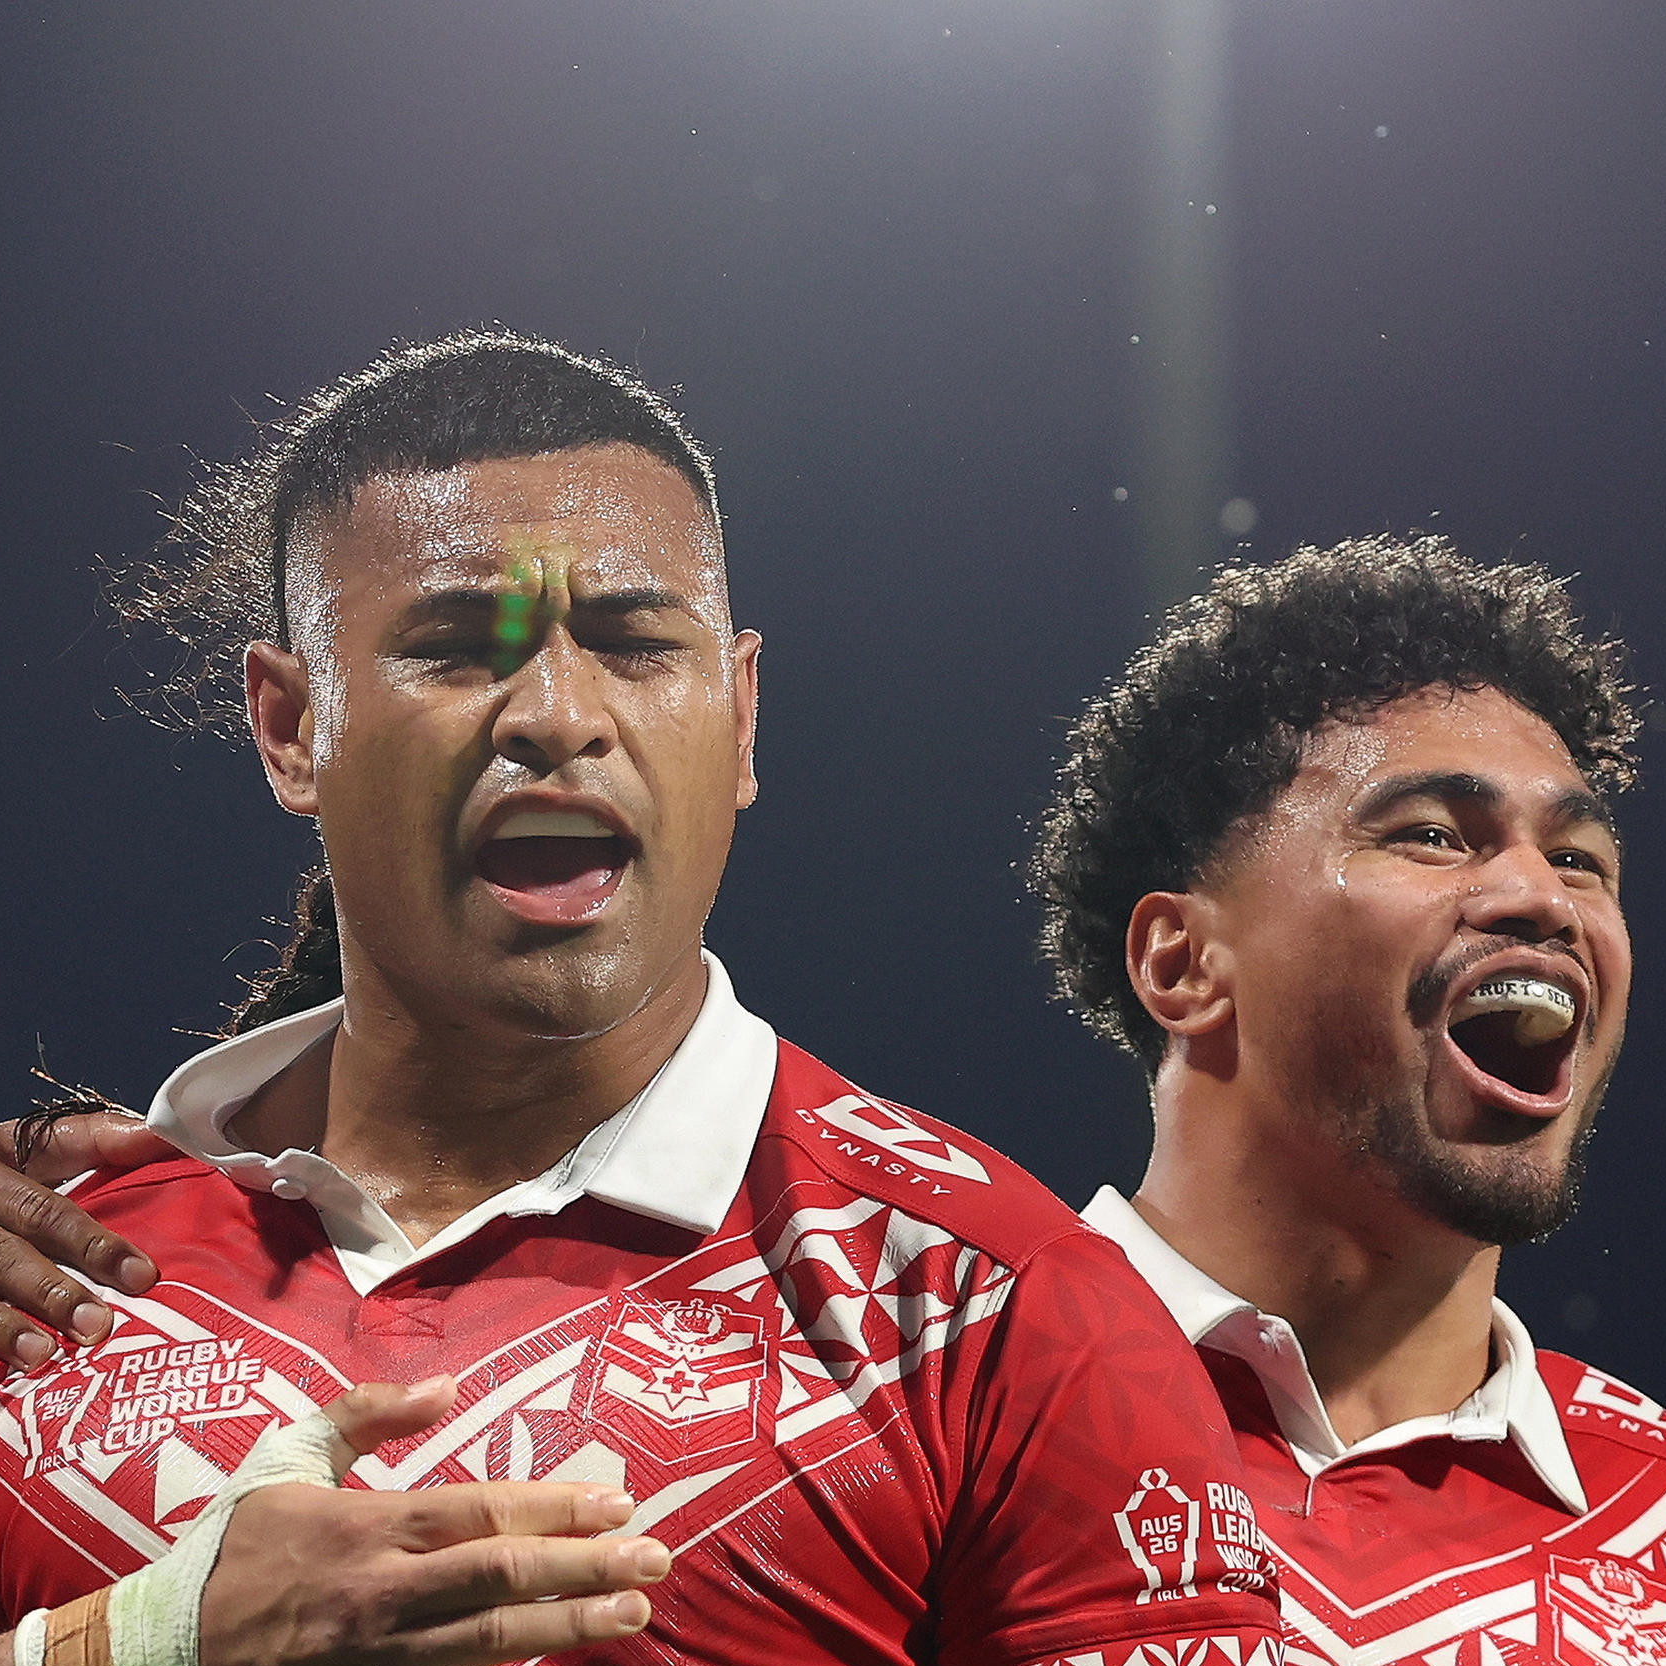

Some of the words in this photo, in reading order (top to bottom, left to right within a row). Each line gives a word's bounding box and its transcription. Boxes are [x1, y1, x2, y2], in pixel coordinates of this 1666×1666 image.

[794, 1108, 952, 1195] DYNASTY
[118, 1338, 245, 1377] RUGBY
[111, 1358, 262, 1400] LEAGUE
[35, 1384, 82, 1410] AUS
[109, 1383, 247, 1424] WORLD
[103, 1416, 176, 1450] CUP
[38, 1454, 62, 1472] IRL
[1205, 1482, 1256, 1522] RUG
[1139, 1514, 1184, 1538] AUS
[1211, 1512, 1273, 1557] LEAG
[1148, 1535, 1179, 1556] 26
[1157, 1589, 1183, 1602] IRL
[1216, 1572, 1265, 1593] CUP
